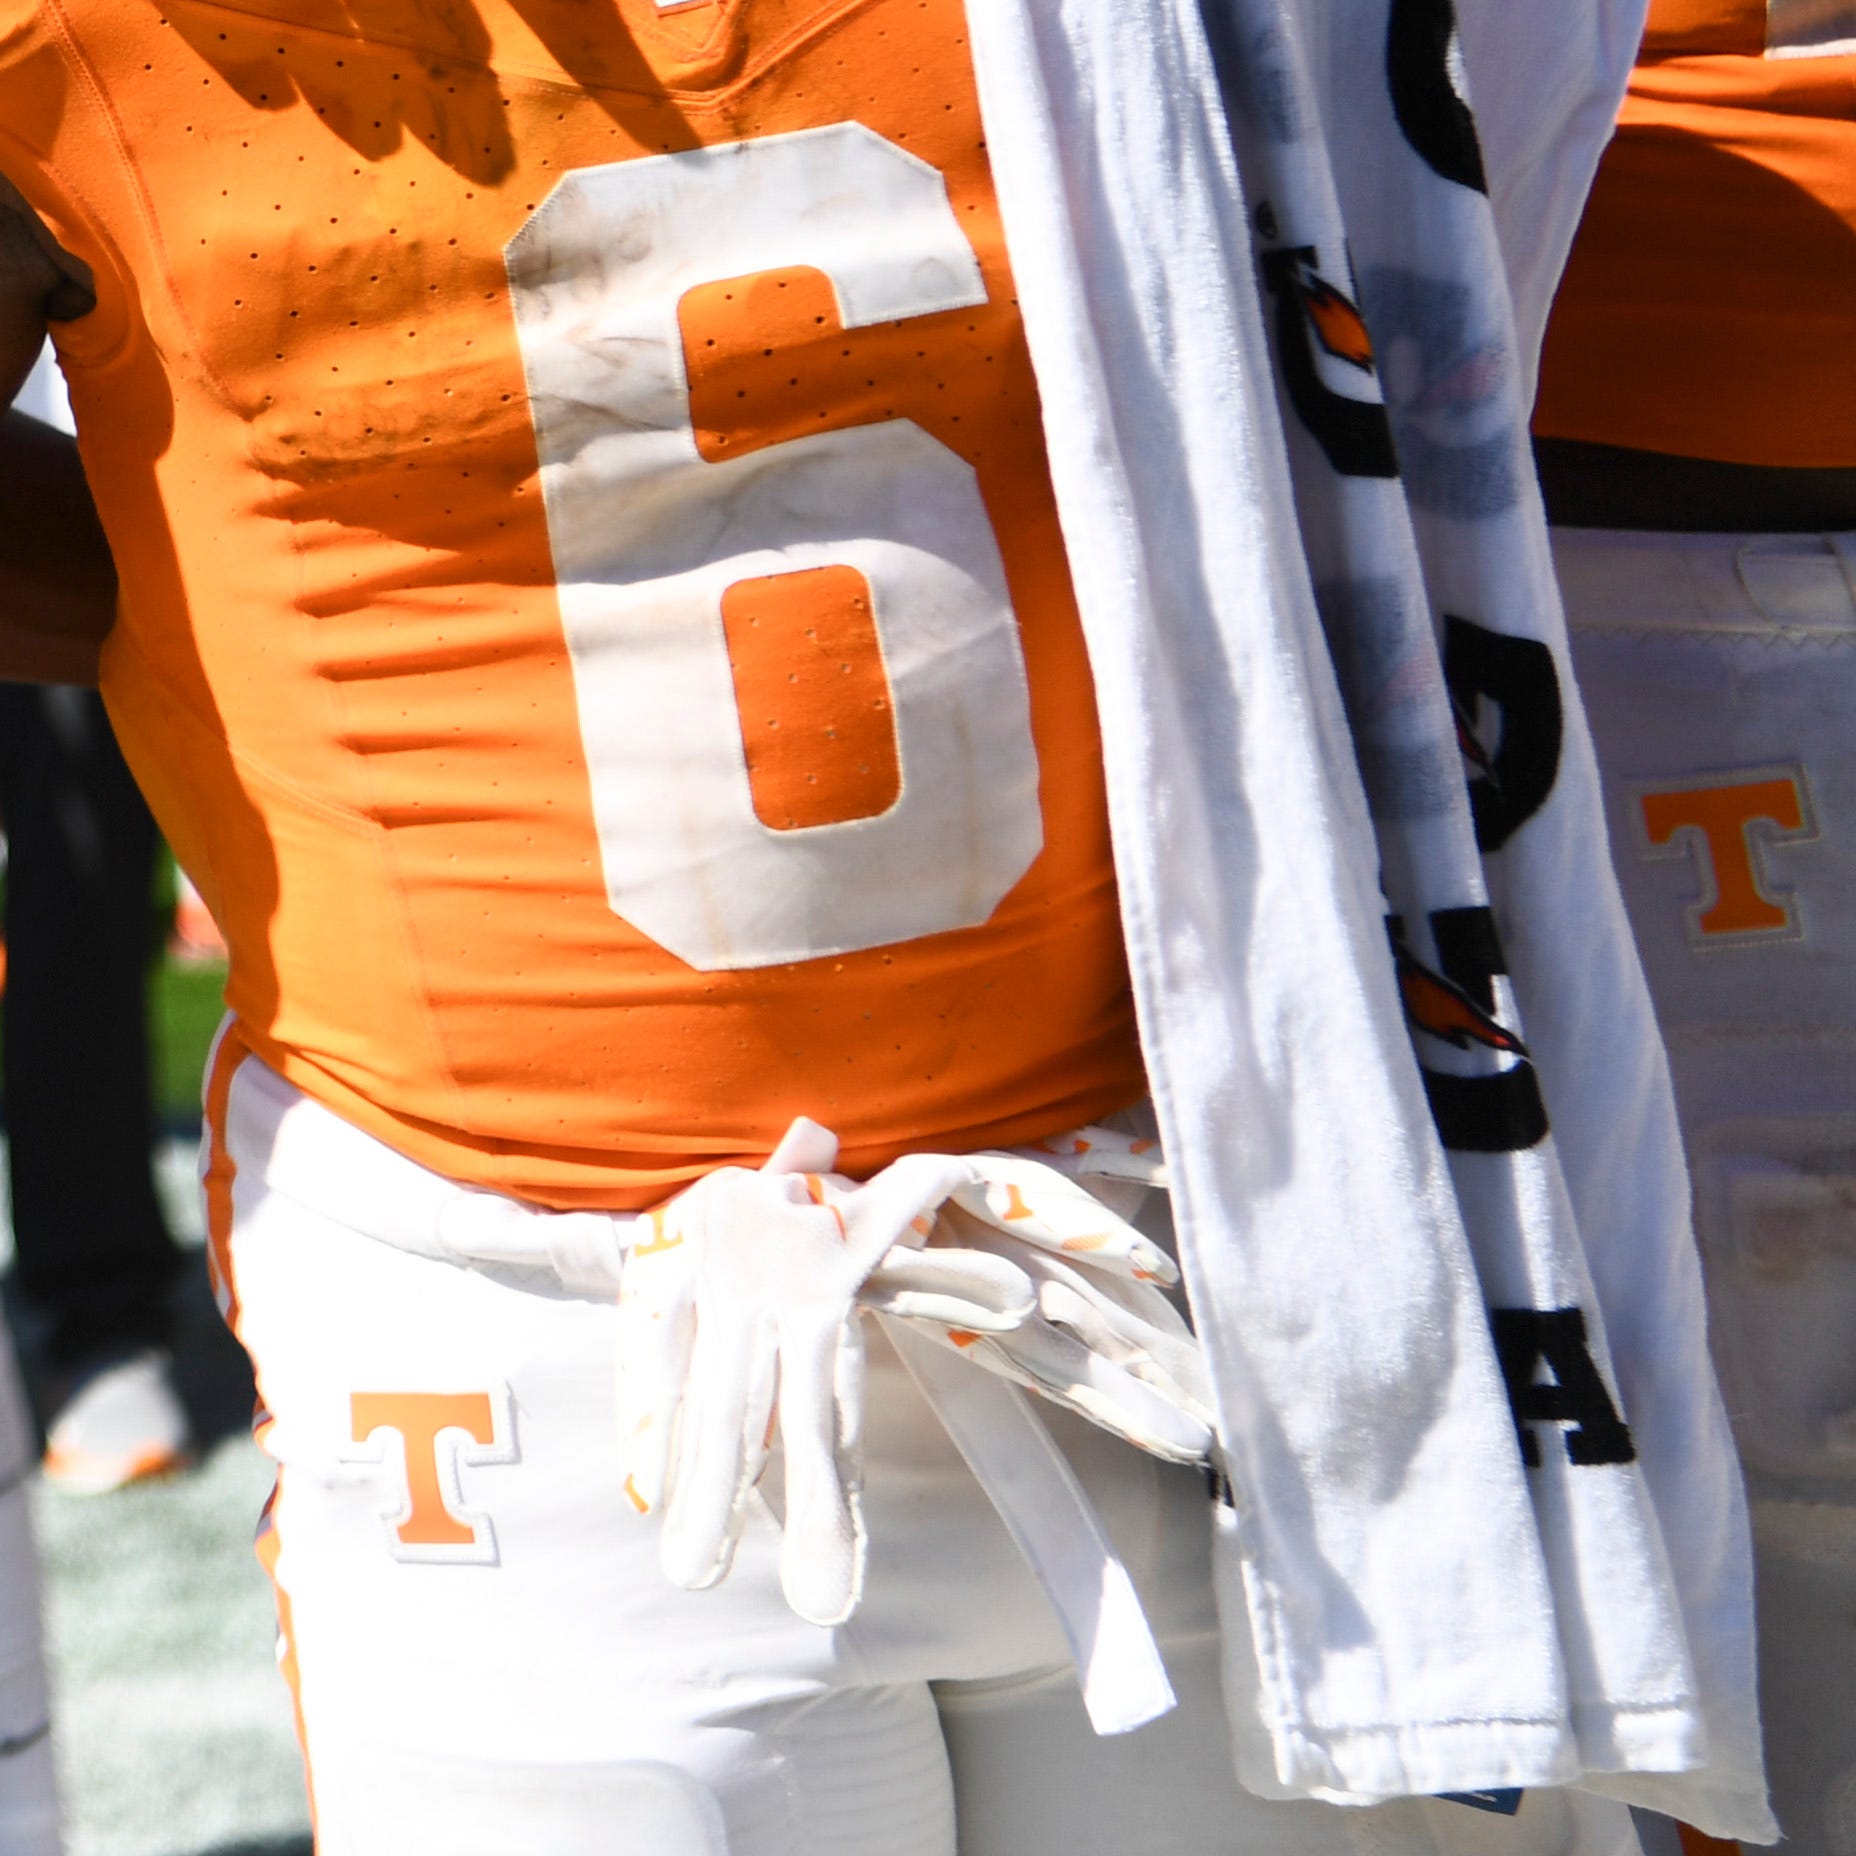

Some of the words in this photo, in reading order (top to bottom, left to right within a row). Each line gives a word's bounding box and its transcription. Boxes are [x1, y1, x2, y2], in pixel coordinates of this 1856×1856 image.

[503, 120, 1045, 972] 6
[1642, 777, 1806, 934] T
[350, 1392, 494, 1544] T
